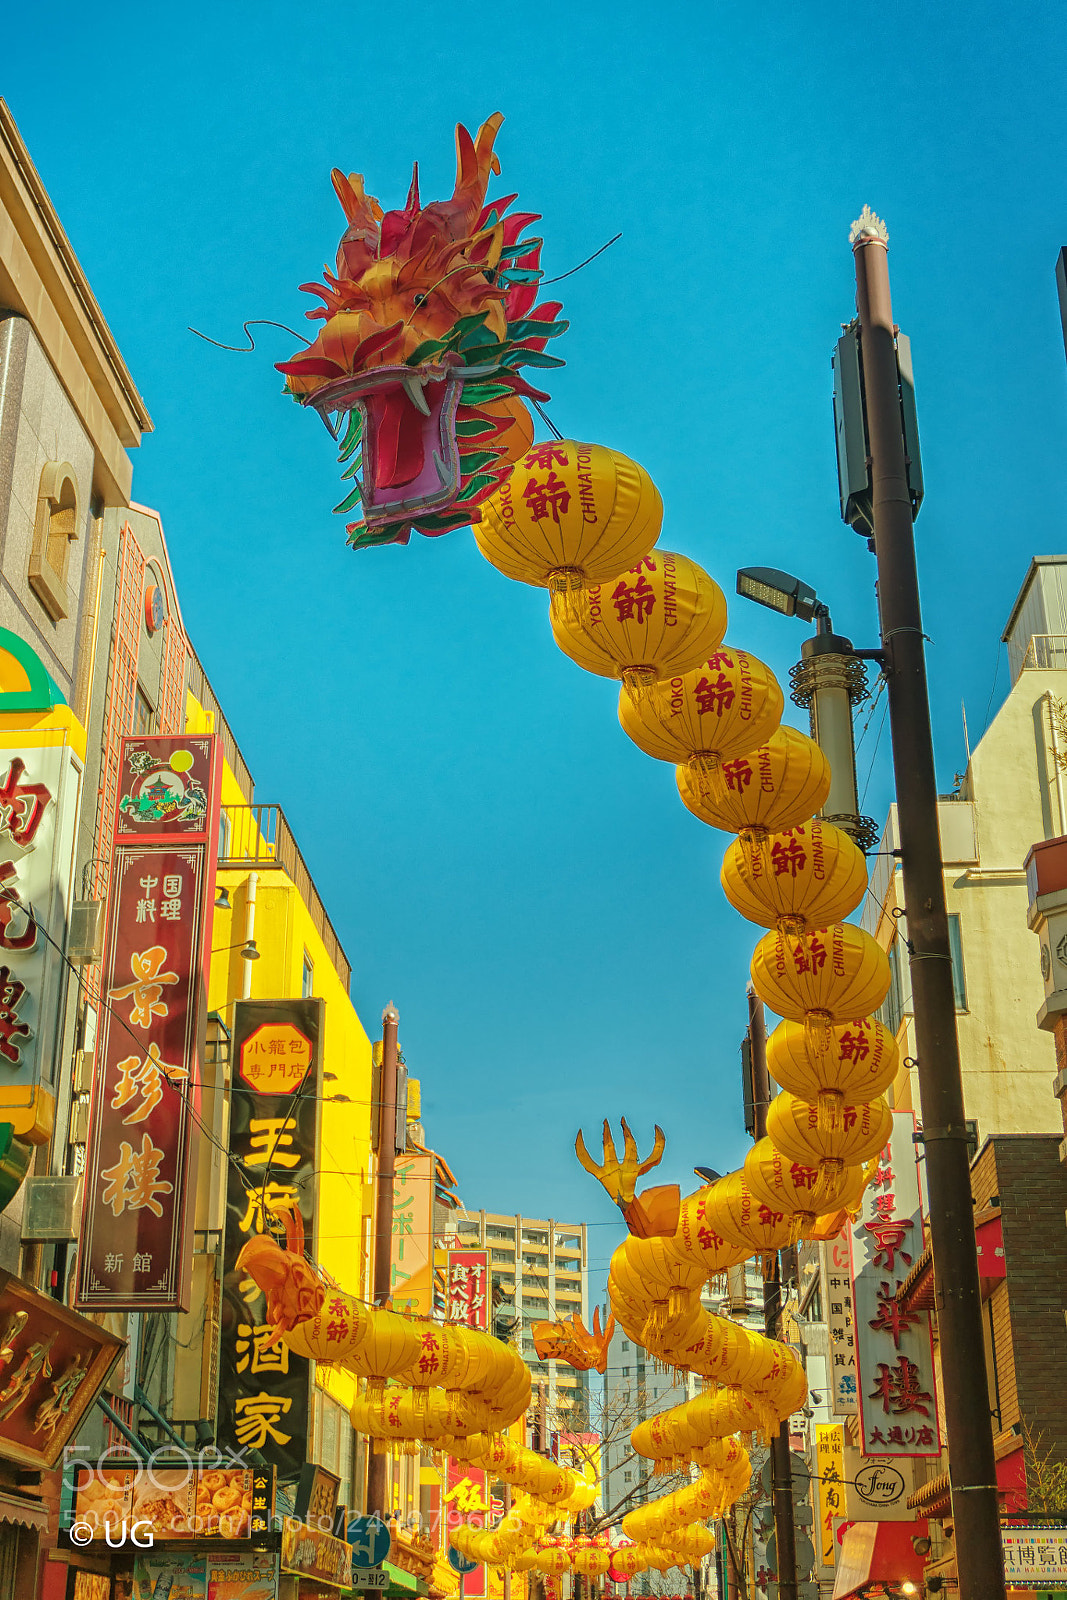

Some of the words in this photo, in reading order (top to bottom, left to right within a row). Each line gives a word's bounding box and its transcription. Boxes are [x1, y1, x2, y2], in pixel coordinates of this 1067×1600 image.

[521, 441, 572, 524] 春節
[771, 825, 807, 878] 節
[138, 874, 183, 899] 中国
[136, 898, 182, 923] 料理
[793, 927, 828, 976] 節
[247, 1038, 306, 1056] 小籠包
[104, 1252, 153, 1274] 新館
[234, 1118, 302, 1450] 王府酒家
[326, 1297, 350, 1344] 春節
[418, 1331, 440, 1375] 春節
[868, 1424, 934, 1447] 大通り店
